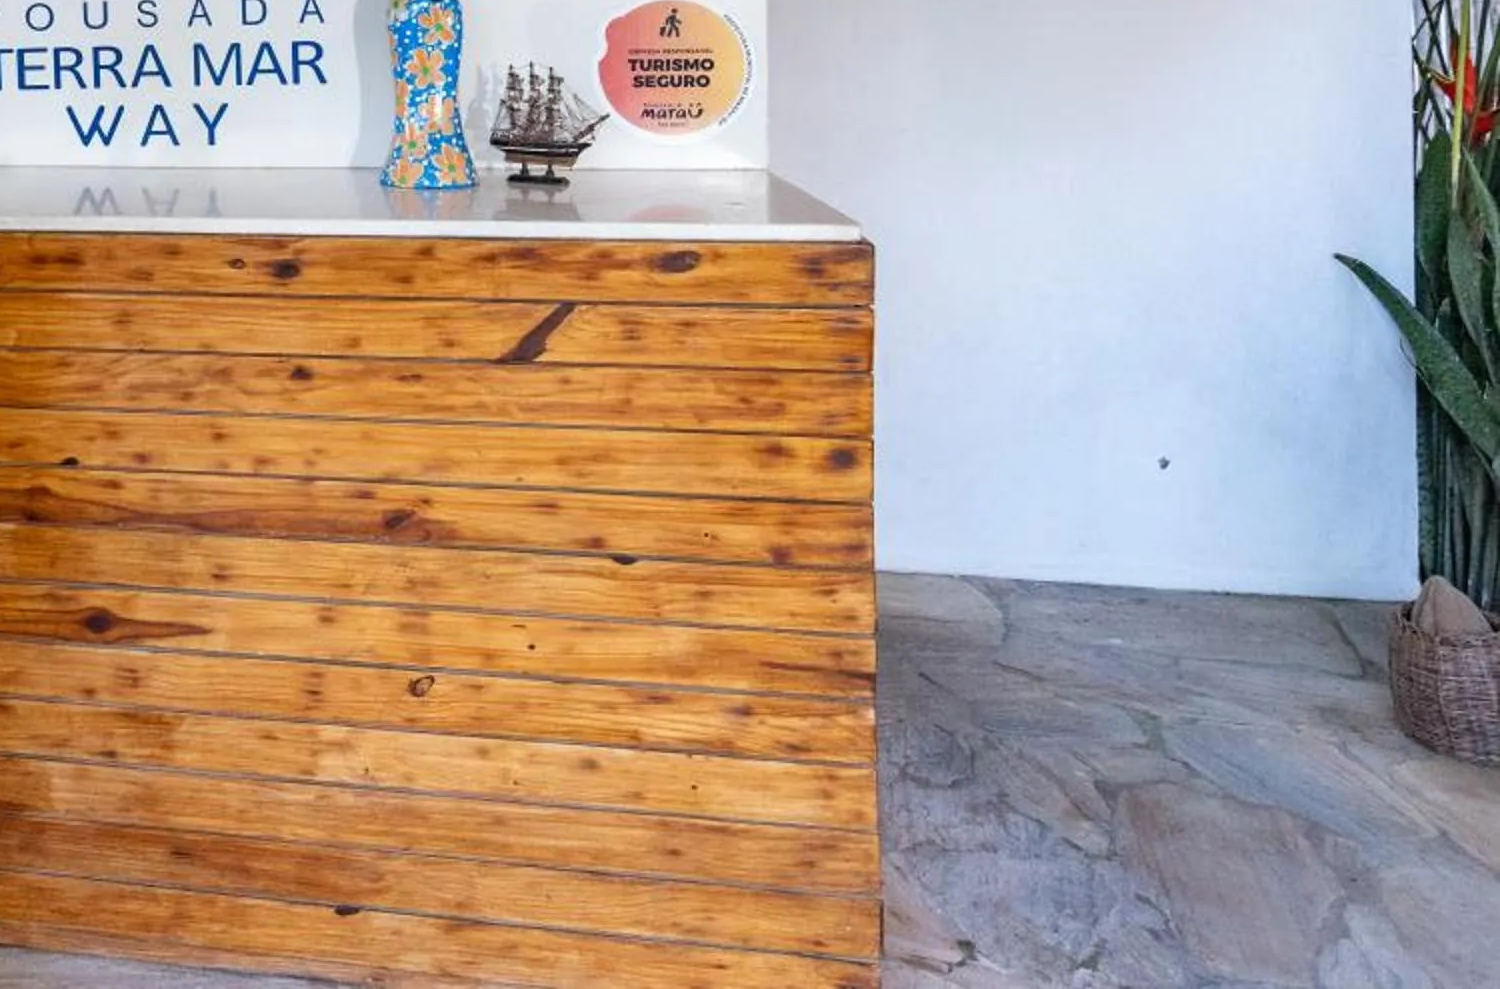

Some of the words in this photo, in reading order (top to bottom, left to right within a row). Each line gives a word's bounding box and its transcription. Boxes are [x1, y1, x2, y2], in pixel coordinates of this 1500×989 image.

[193, 41, 327, 87] MAR
[628, 58, 715, 71] TURISMO
[633, 74, 710, 88] SEGURO
[66, 102, 228, 147] WAY
